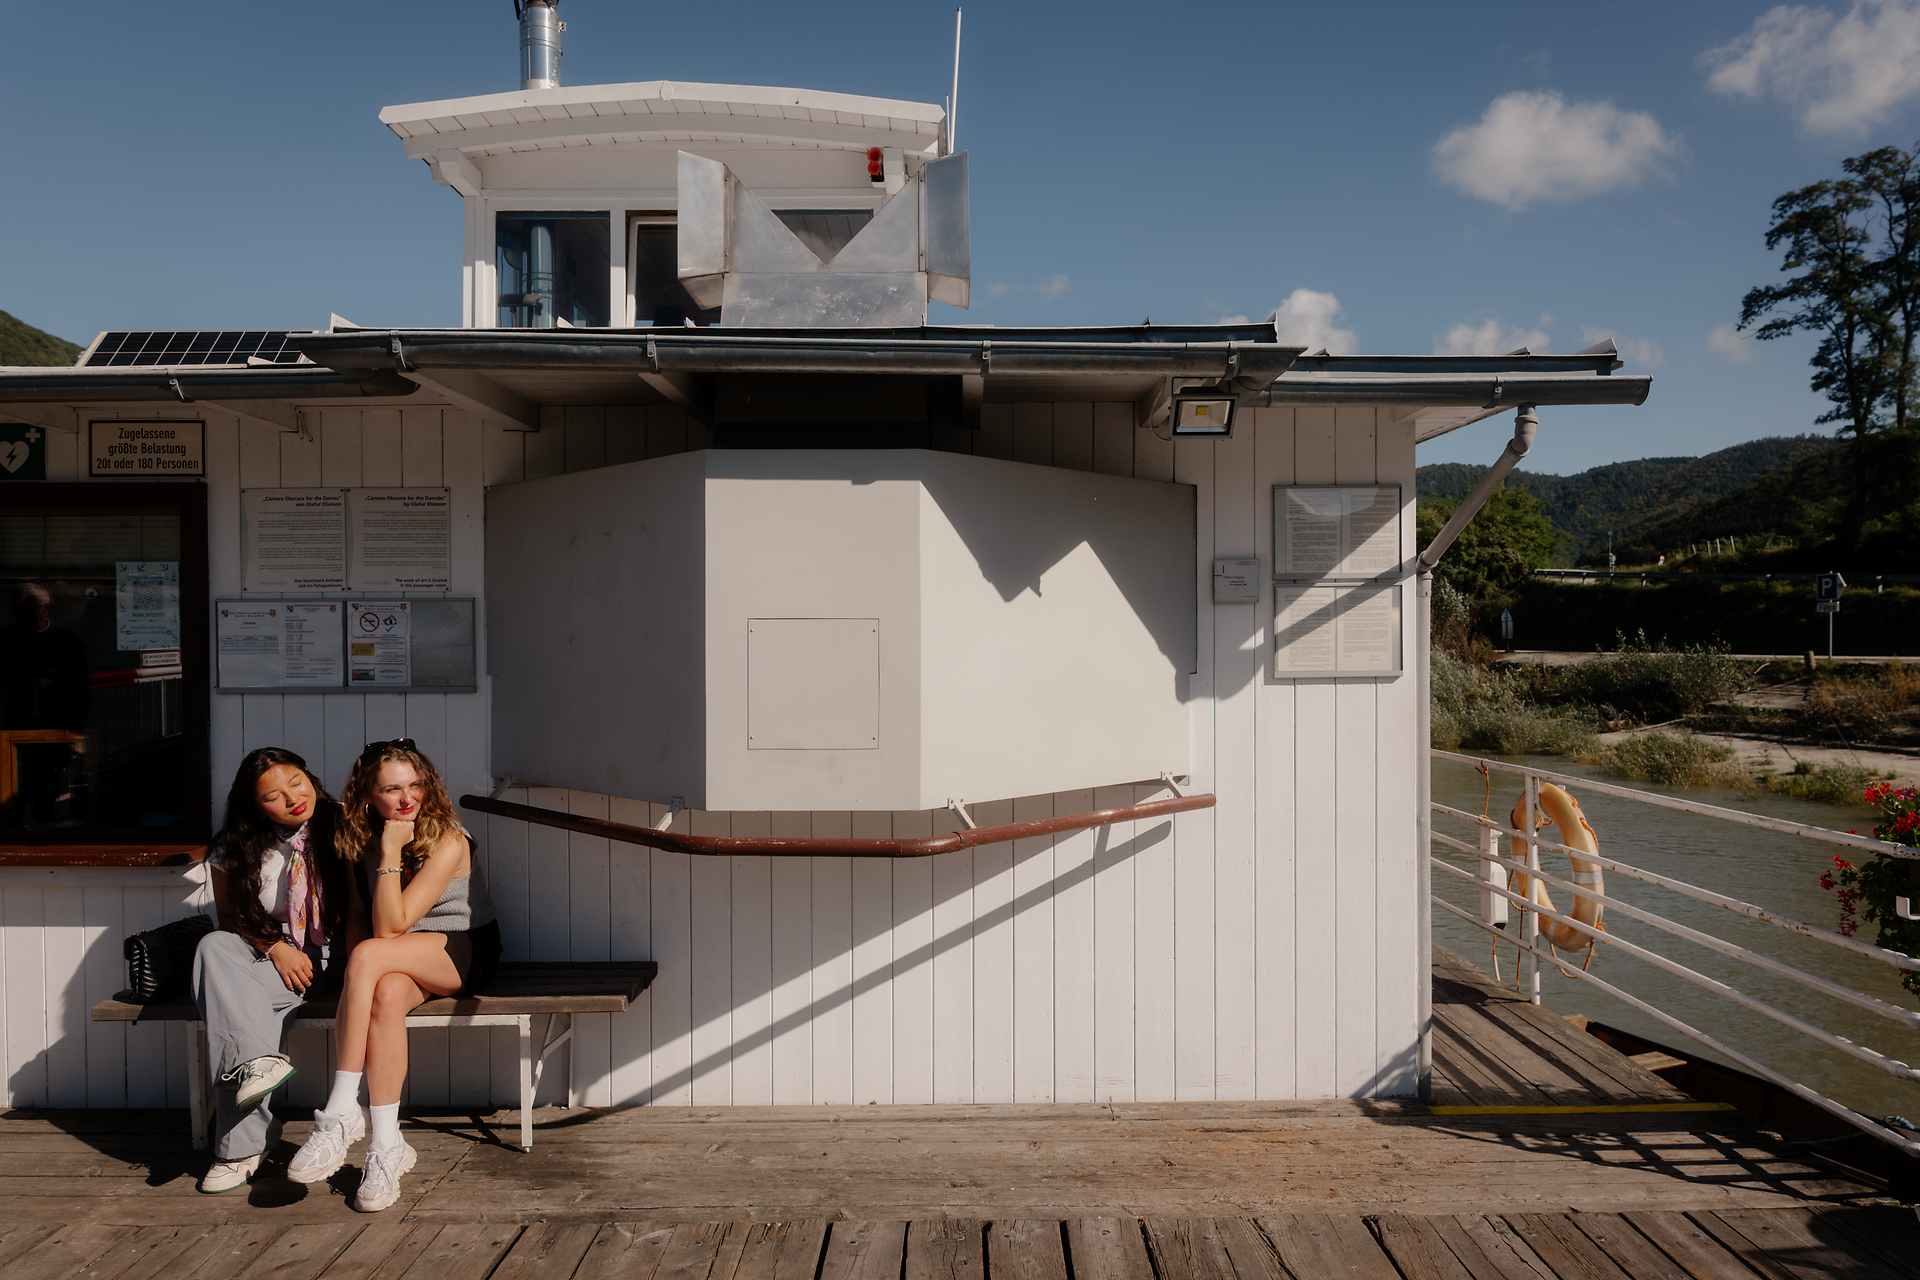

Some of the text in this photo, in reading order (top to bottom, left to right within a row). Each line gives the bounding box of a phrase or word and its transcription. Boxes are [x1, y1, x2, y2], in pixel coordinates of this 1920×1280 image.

[118, 428, 176, 442] Zugelassene
[108, 442, 186, 456] größte Belastung
[96, 458, 199, 469] 20t oder 180 Personen
[1822, 578, 1832, 596] P
